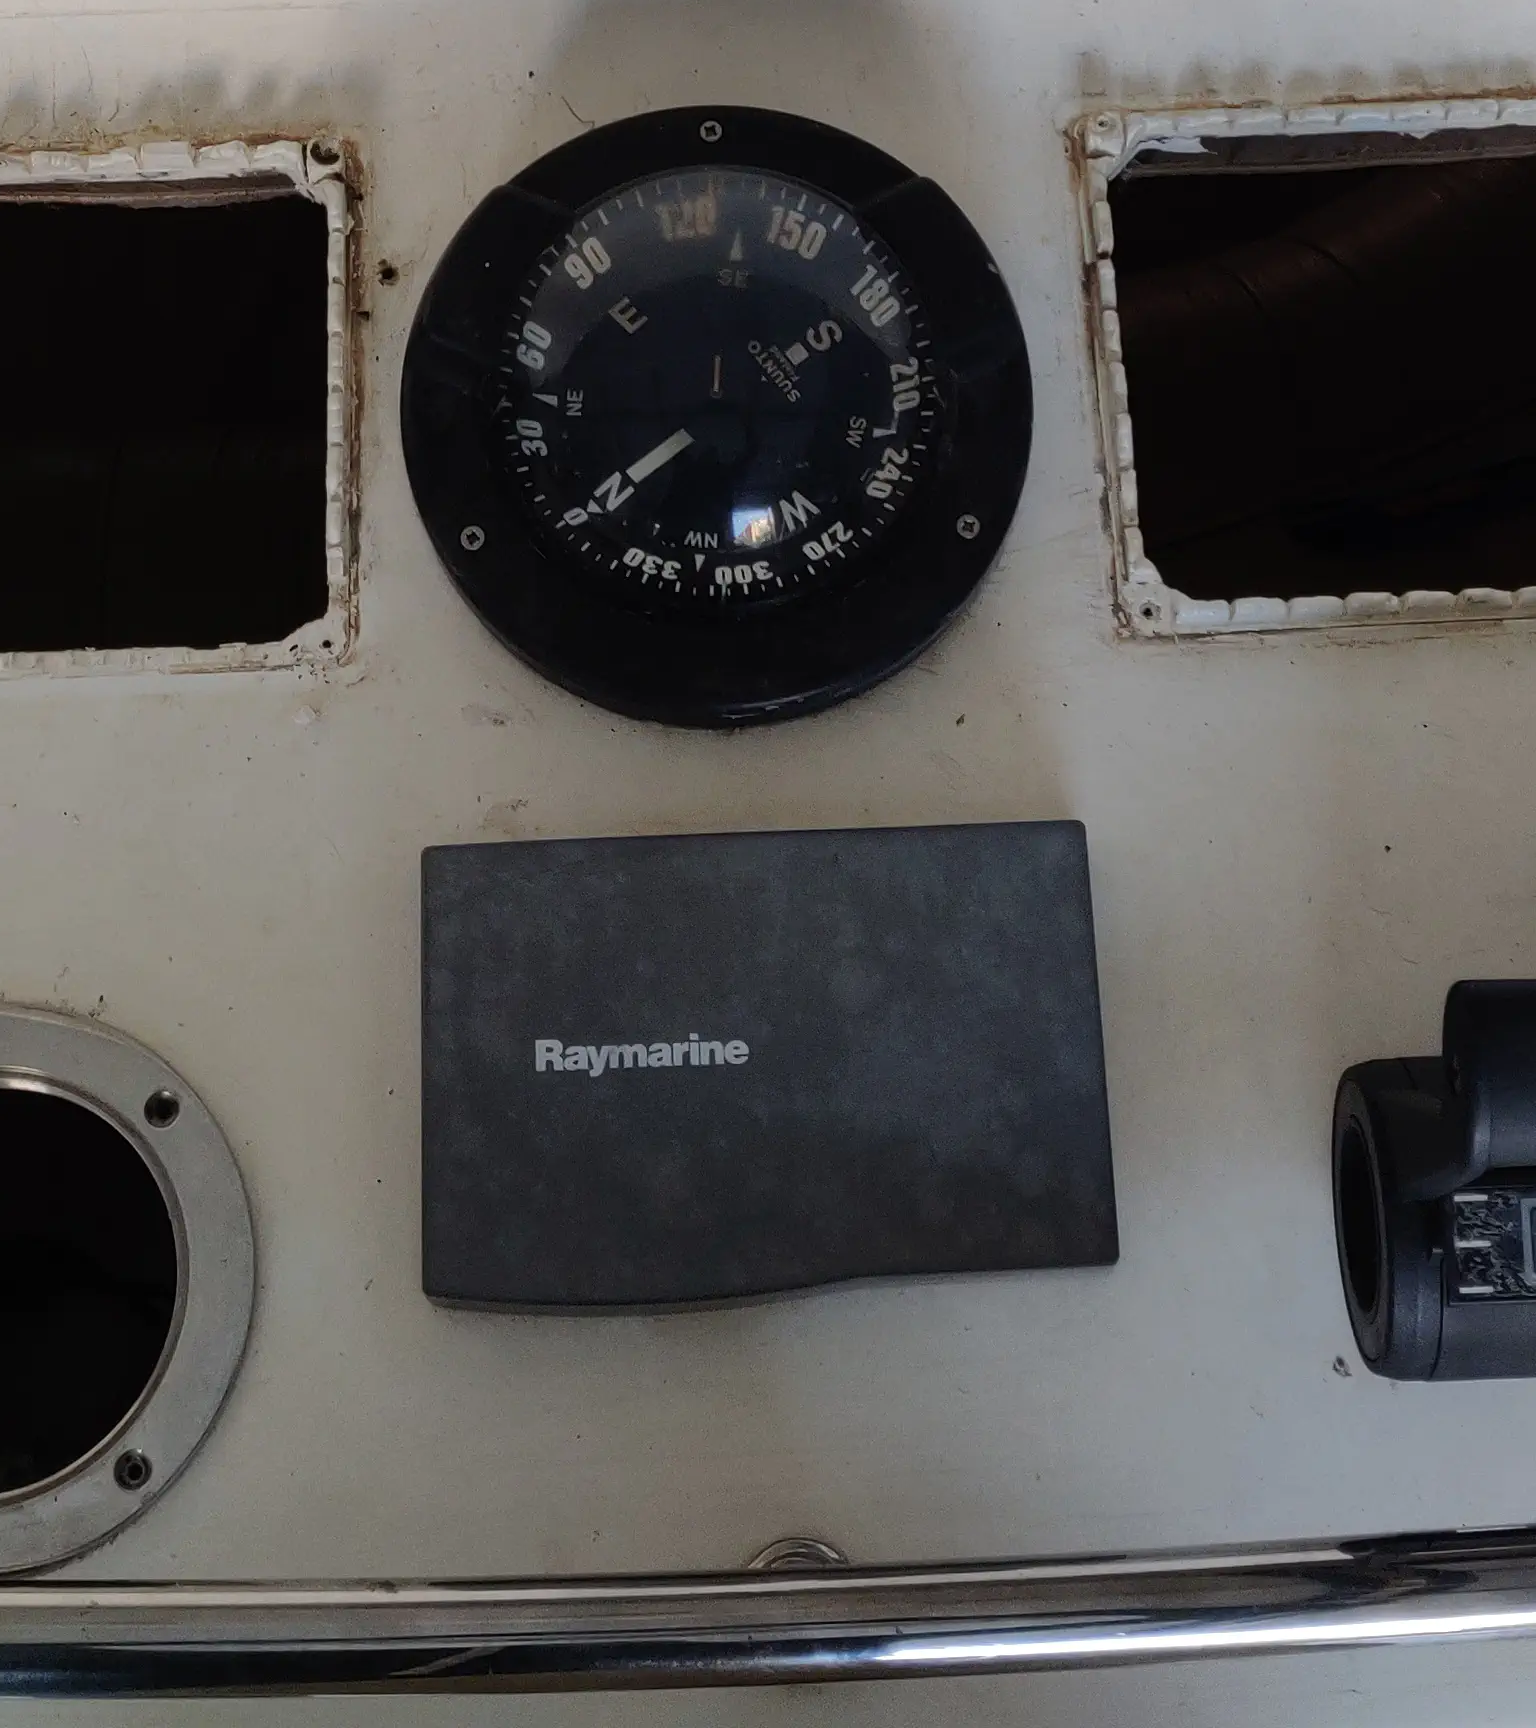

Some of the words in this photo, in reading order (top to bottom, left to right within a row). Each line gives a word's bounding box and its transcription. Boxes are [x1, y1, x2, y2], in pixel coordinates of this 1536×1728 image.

[766, 205, 827, 260] 150
[564, 236, 612, 290] 90
[608, 296, 648, 334] E
[850, 263, 901, 327] 180
[516, 320, 552, 370] 60
[806, 319, 843, 351] S
[747, 340, 802, 403] SUUNTO
[889, 356, 920, 412] 210
[566, 388, 584, 417] NE
[515, 419, 549, 457] 30
[845, 416, 867, 449] SW
[593, 471, 635, 513] N
[866, 447, 909, 501] 240
[779, 490, 821, 532] W
[684, 530, 719, 550] NW
[802, 521, 854, 561] 270
[622, 547, 682, 581] 330
[714, 559, 775, 586] 300
[534, 1032, 750, 1078] Raymarine
